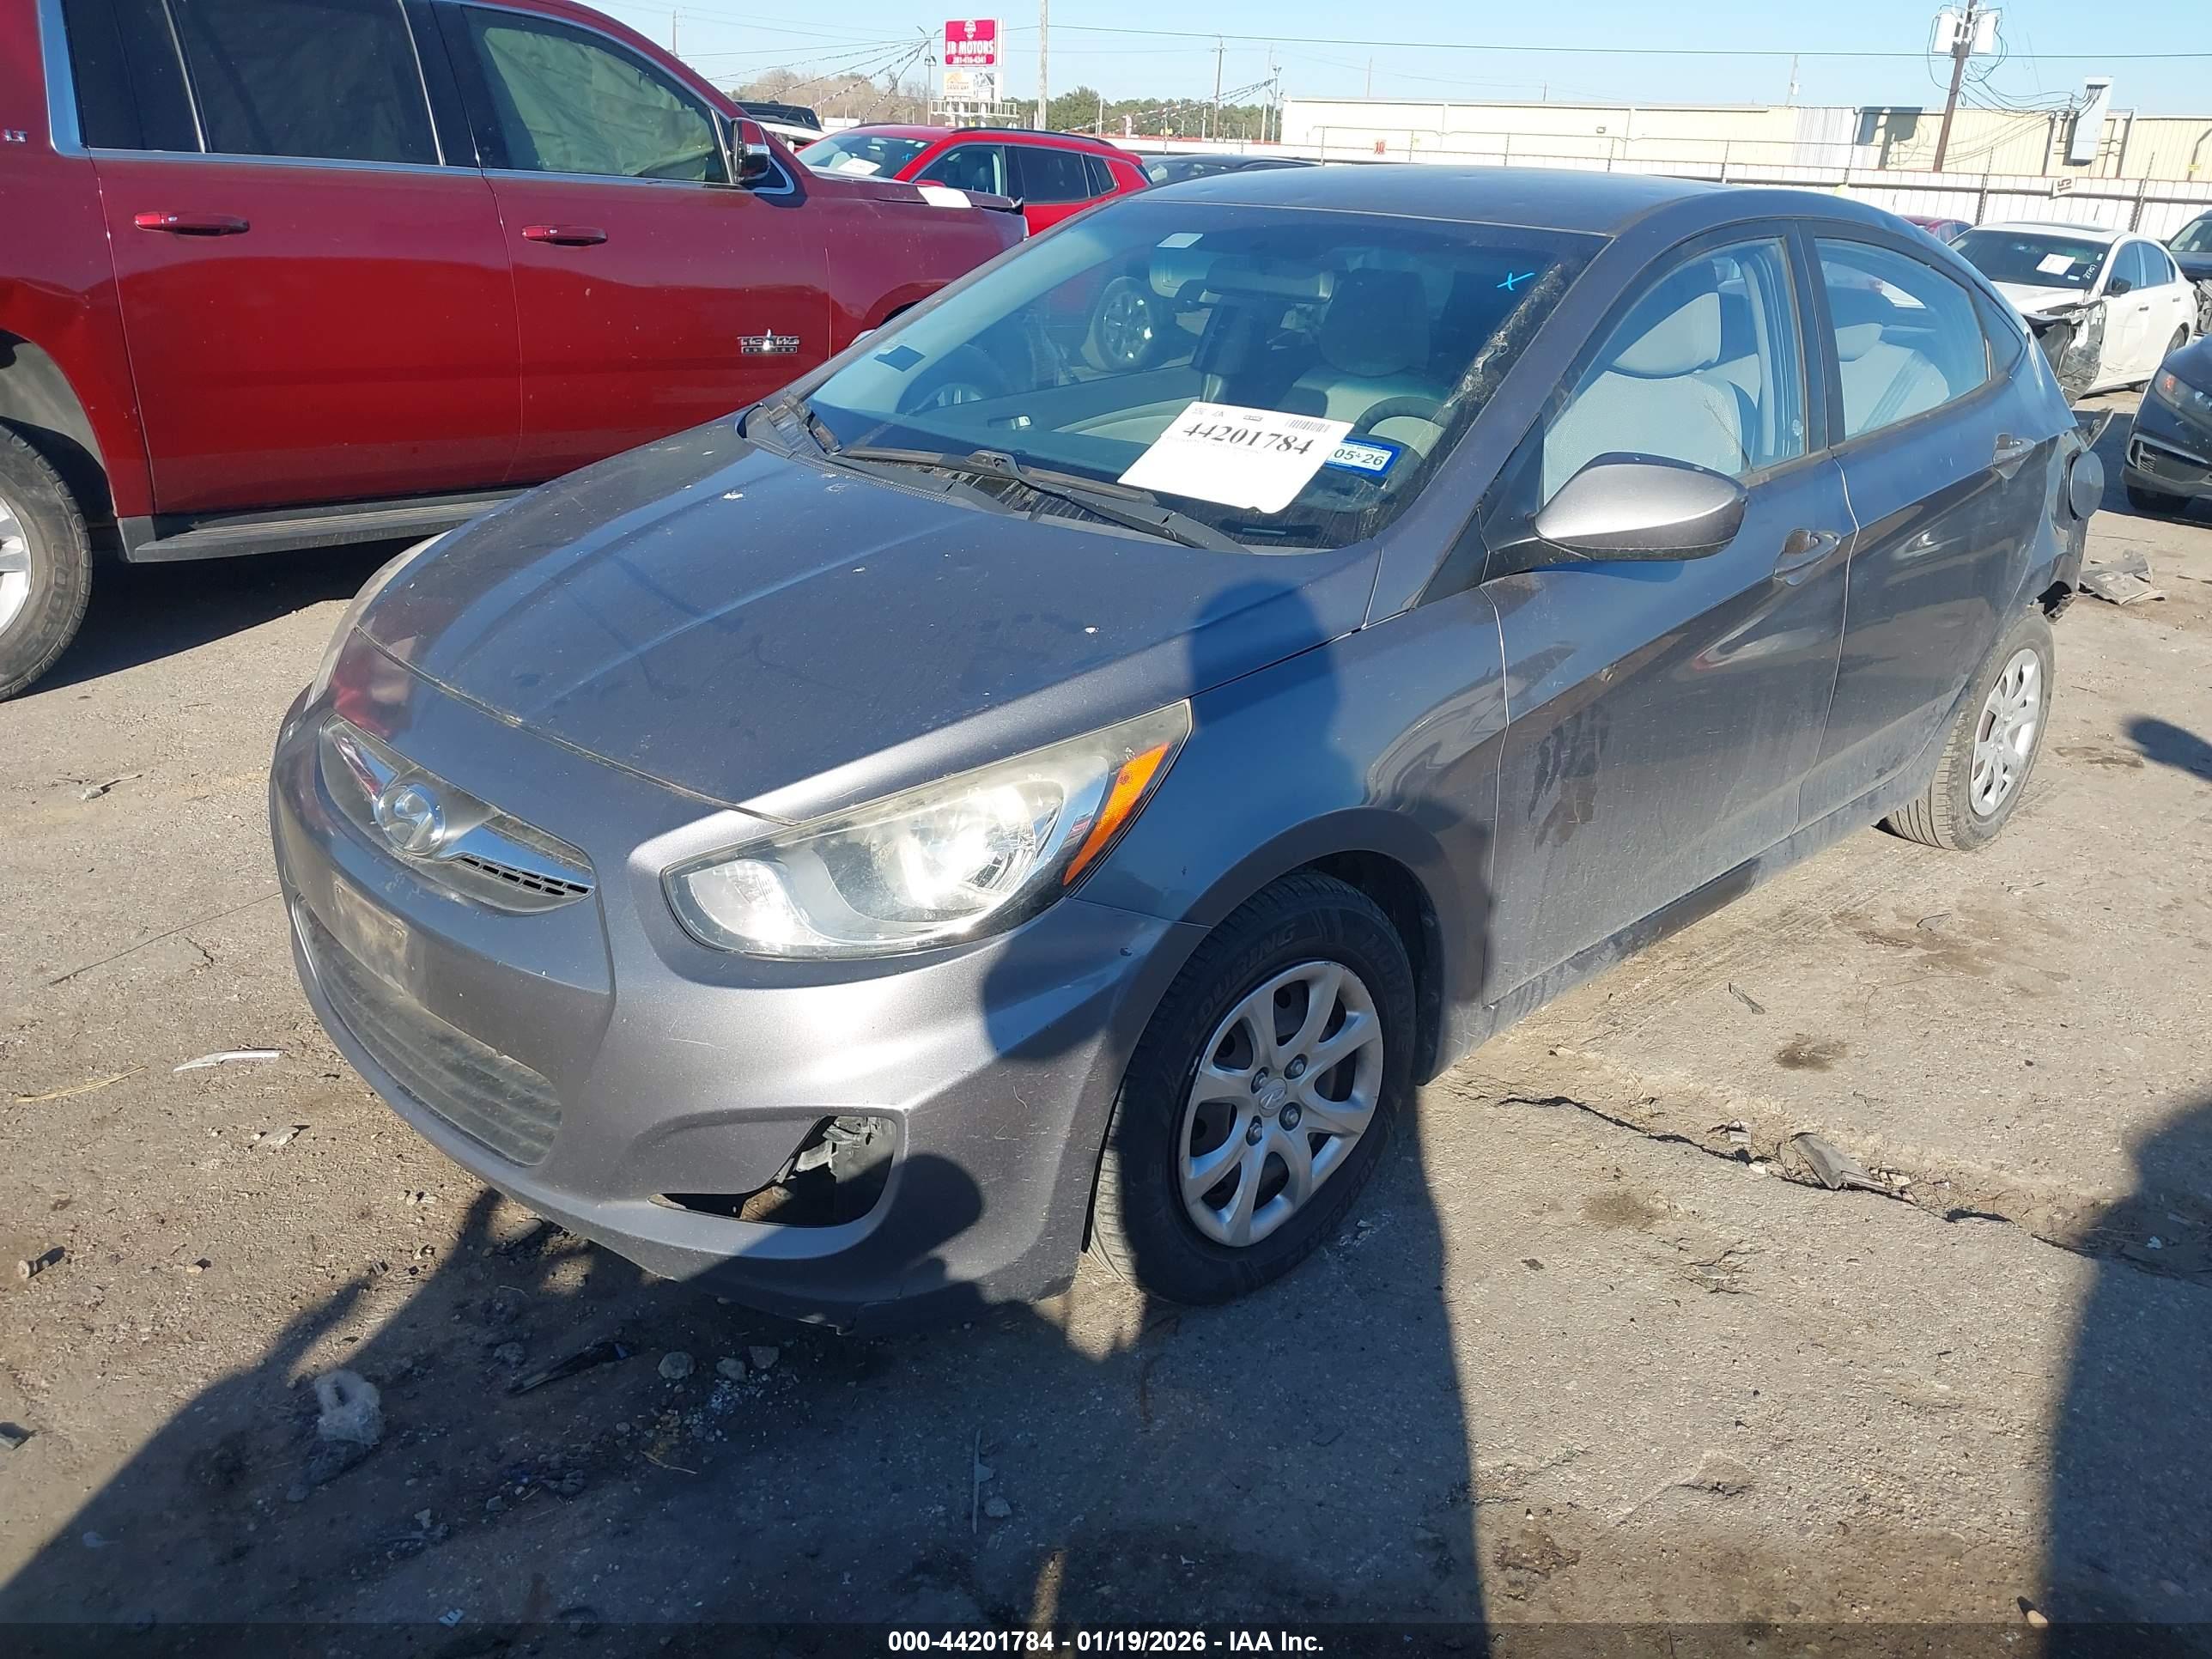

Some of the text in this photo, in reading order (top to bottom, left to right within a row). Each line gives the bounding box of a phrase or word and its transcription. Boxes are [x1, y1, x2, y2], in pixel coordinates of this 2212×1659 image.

[946, 40, 994, 54] JB MOTORS
[5, 129, 27, 143] LT
[2057, 178, 2072, 193] 15
[1182, 422, 1315, 454] 44201784
